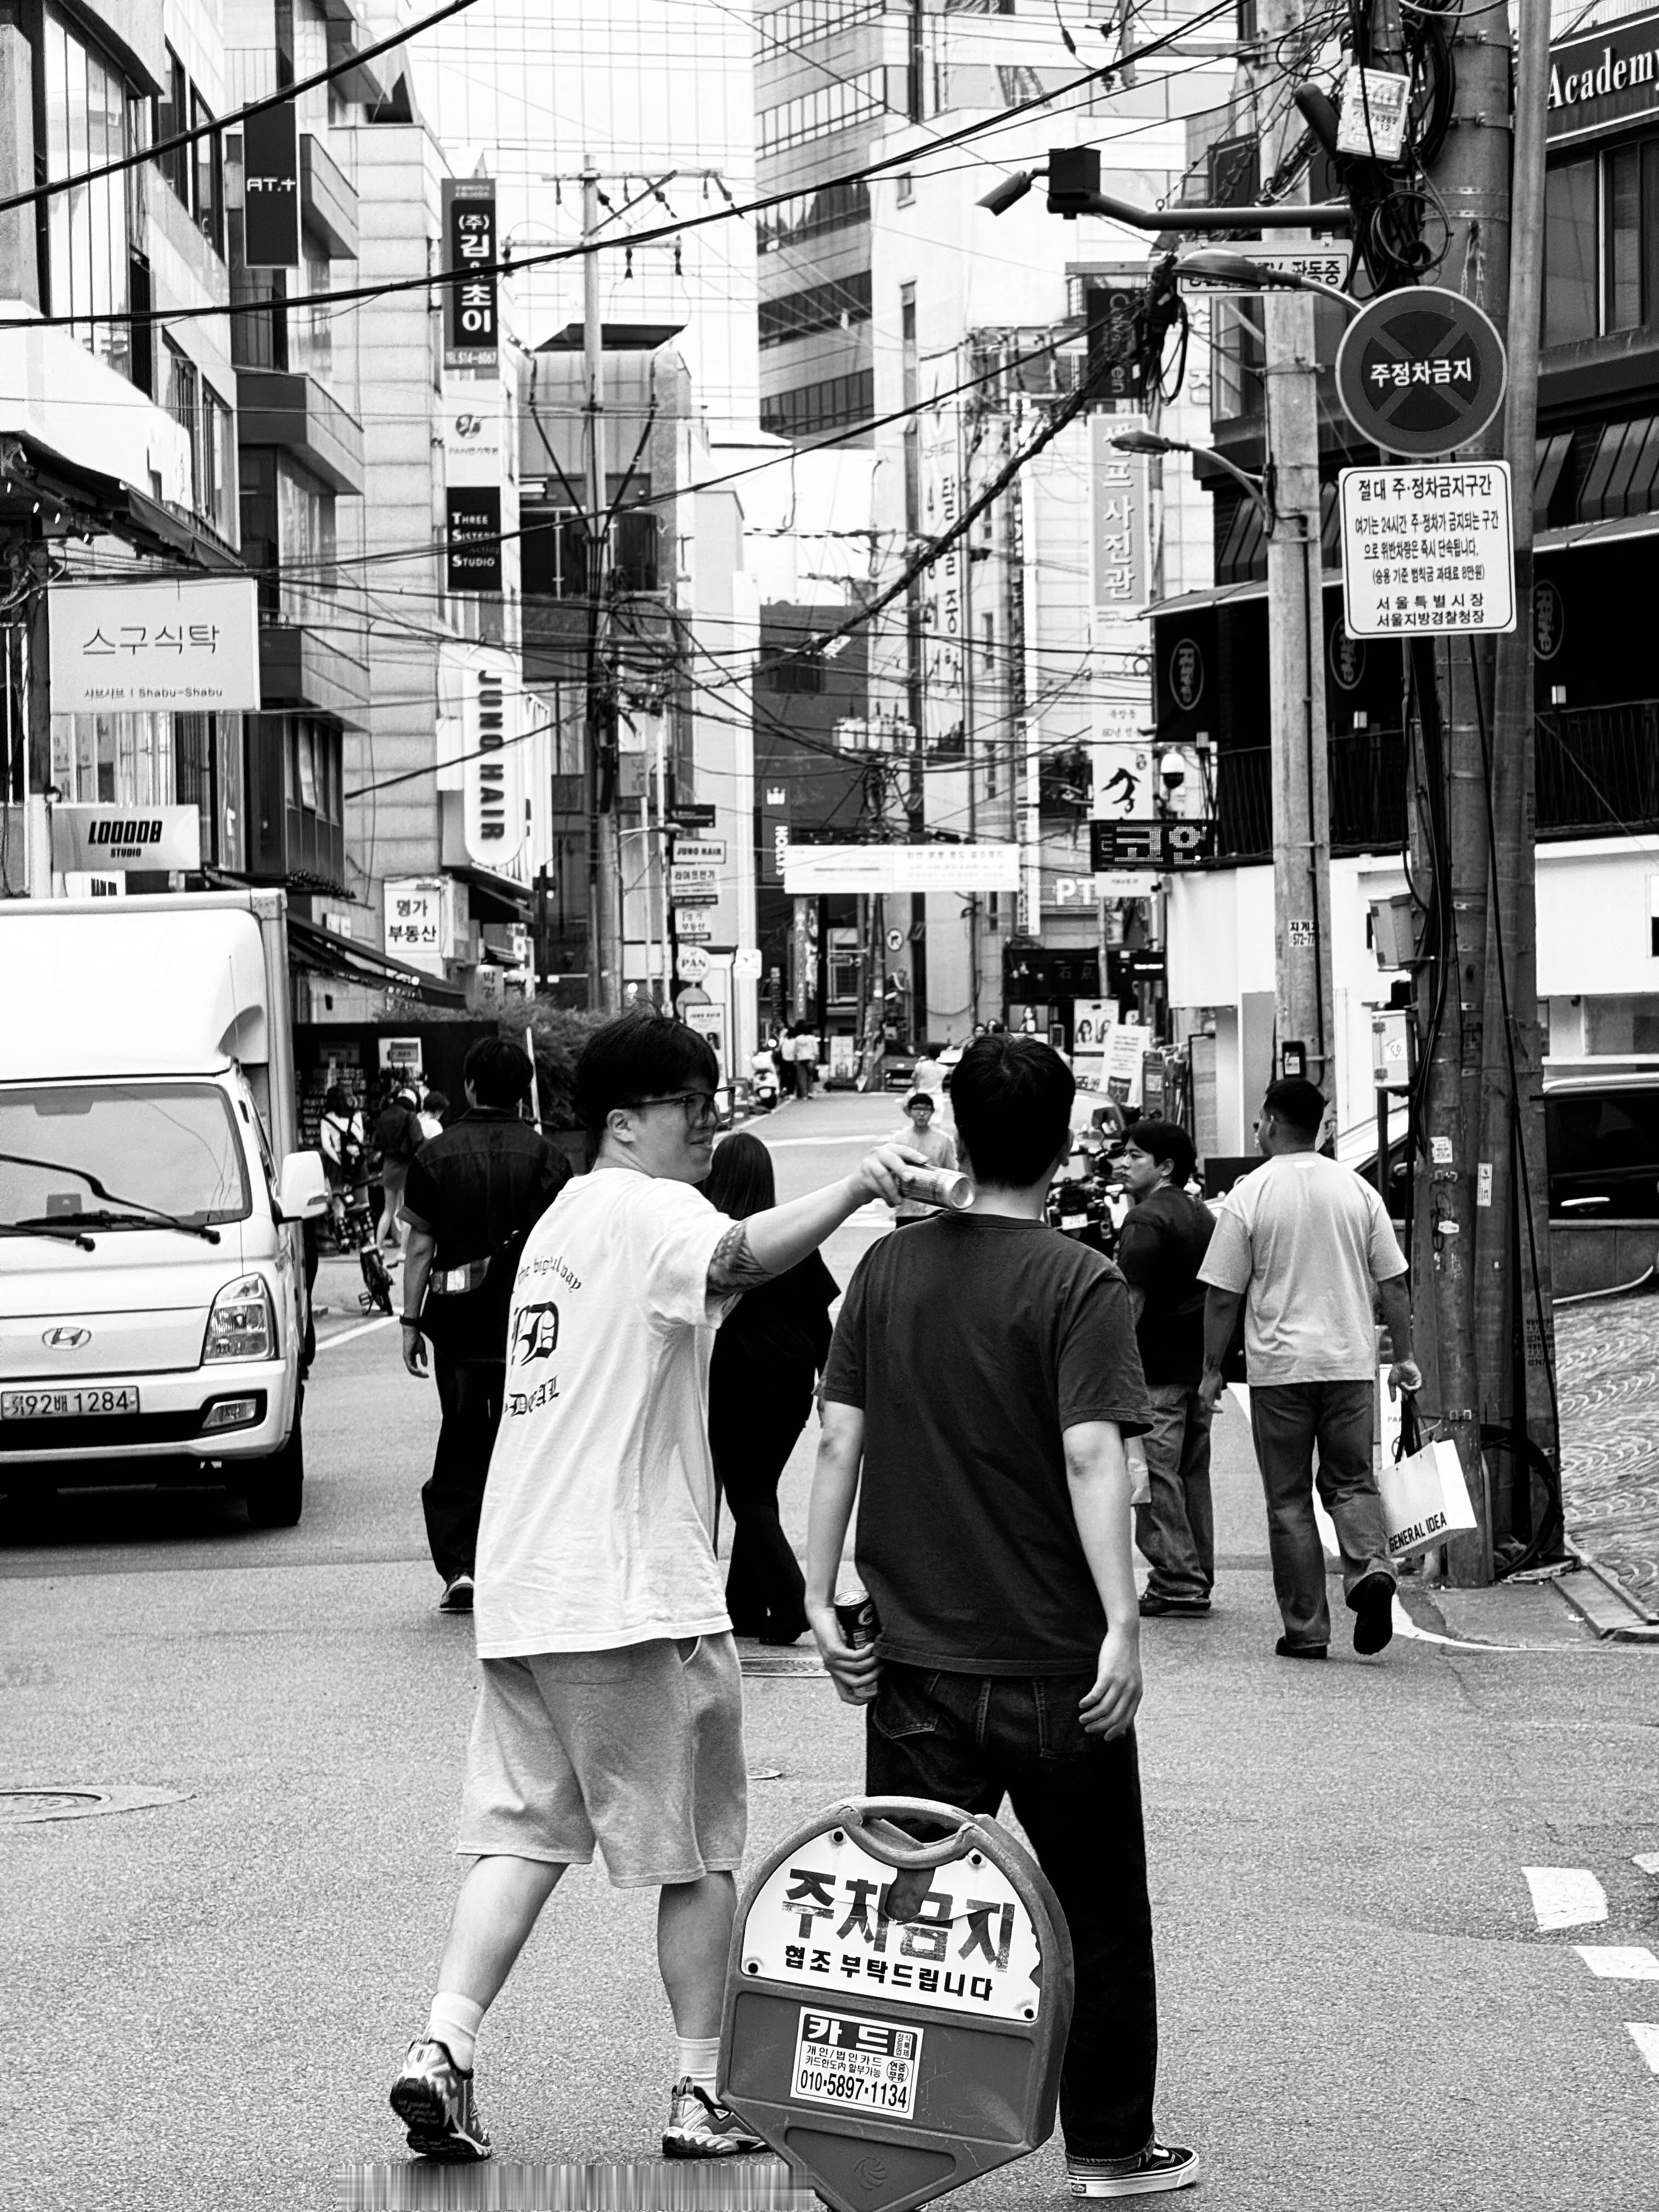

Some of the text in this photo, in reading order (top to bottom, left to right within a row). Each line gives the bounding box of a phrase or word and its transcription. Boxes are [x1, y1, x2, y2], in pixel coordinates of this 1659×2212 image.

[1370, 358, 1472, 387] 주정차금지
[1358, 478, 1386, 501] 절대
[452, 511, 488, 525] THREE
[1355, 515, 1379, 535] 여기는
[1381, 514, 1407, 534] 24시간
[1448, 511, 1480, 532] 금지되는
[1482, 509, 1499, 530] 구간
[1364, 543, 1379, 560] 으로
[1381, 540, 1419, 560] 위반차량은
[1421, 538, 1436, 558] 즉시
[452, 554, 495, 567] STUDIO
[1373, 567, 1391, 585] (승용
[1393, 567, 1408, 584] 기준
[1411, 566, 1434, 583] 범칙금
[1436, 565, 1460, 582] 과태료
[1376, 610, 1484, 627] 서울지방경찰청장
[83, 624, 220, 656] 스구식탁
[479, 764, 505, 840] HAIR
[111, 848, 142, 858] STUDIO
[396, 898, 428, 917] 명가
[388, 925, 437, 943] 부동산
[1290, 921, 1314, 932] 지게
[74, 1390, 129, 1413] 1284
[1389, 1511, 1447, 1553] GENERAL IDEA
[782, 1868, 1015, 1973] 주차금지
[785, 1945, 993, 2001] 협조 부탁드립니다
[807, 2016, 889, 2053] 카드
[849, 2064, 882, 2078] 할부가능
